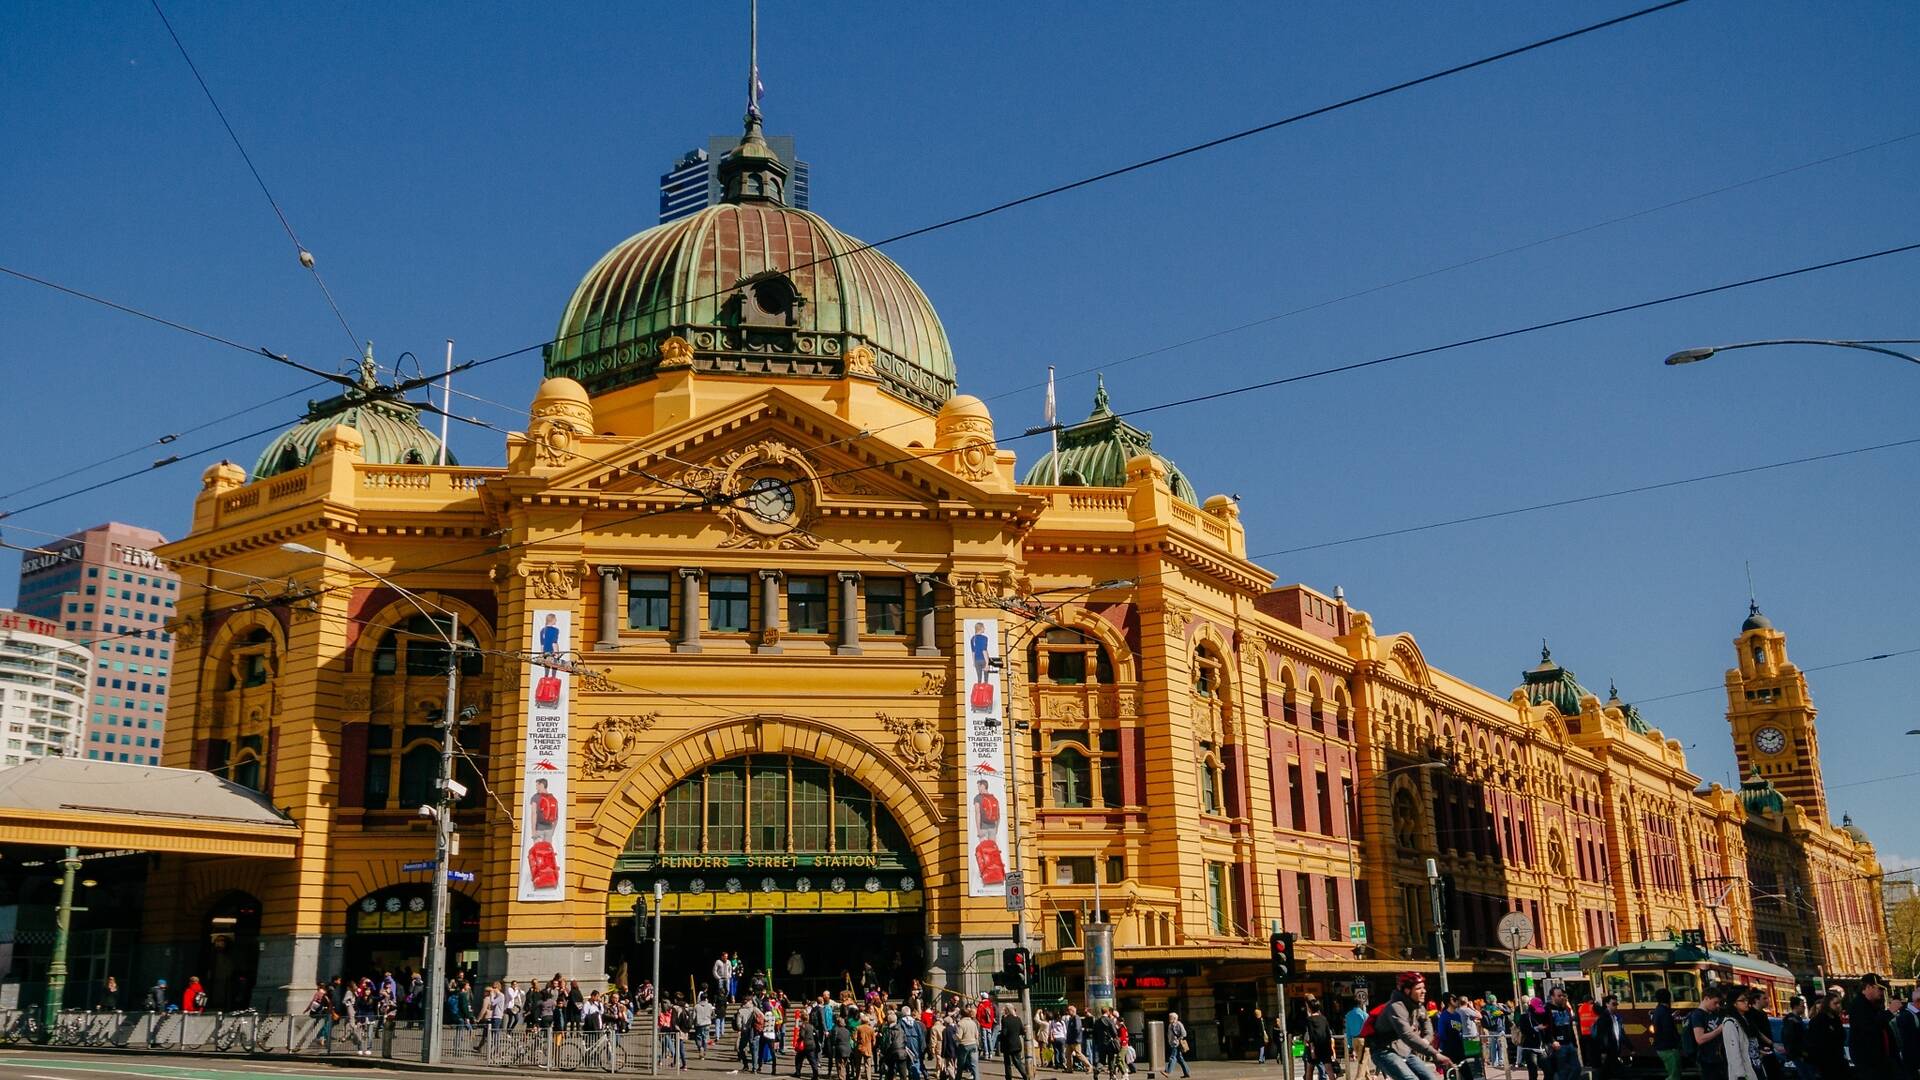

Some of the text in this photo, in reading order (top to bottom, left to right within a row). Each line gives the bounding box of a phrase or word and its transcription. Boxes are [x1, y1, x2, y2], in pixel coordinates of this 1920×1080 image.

[661, 855, 877, 868] FLINDERS STREET STATION
[1686, 932, 1701, 944] 35
